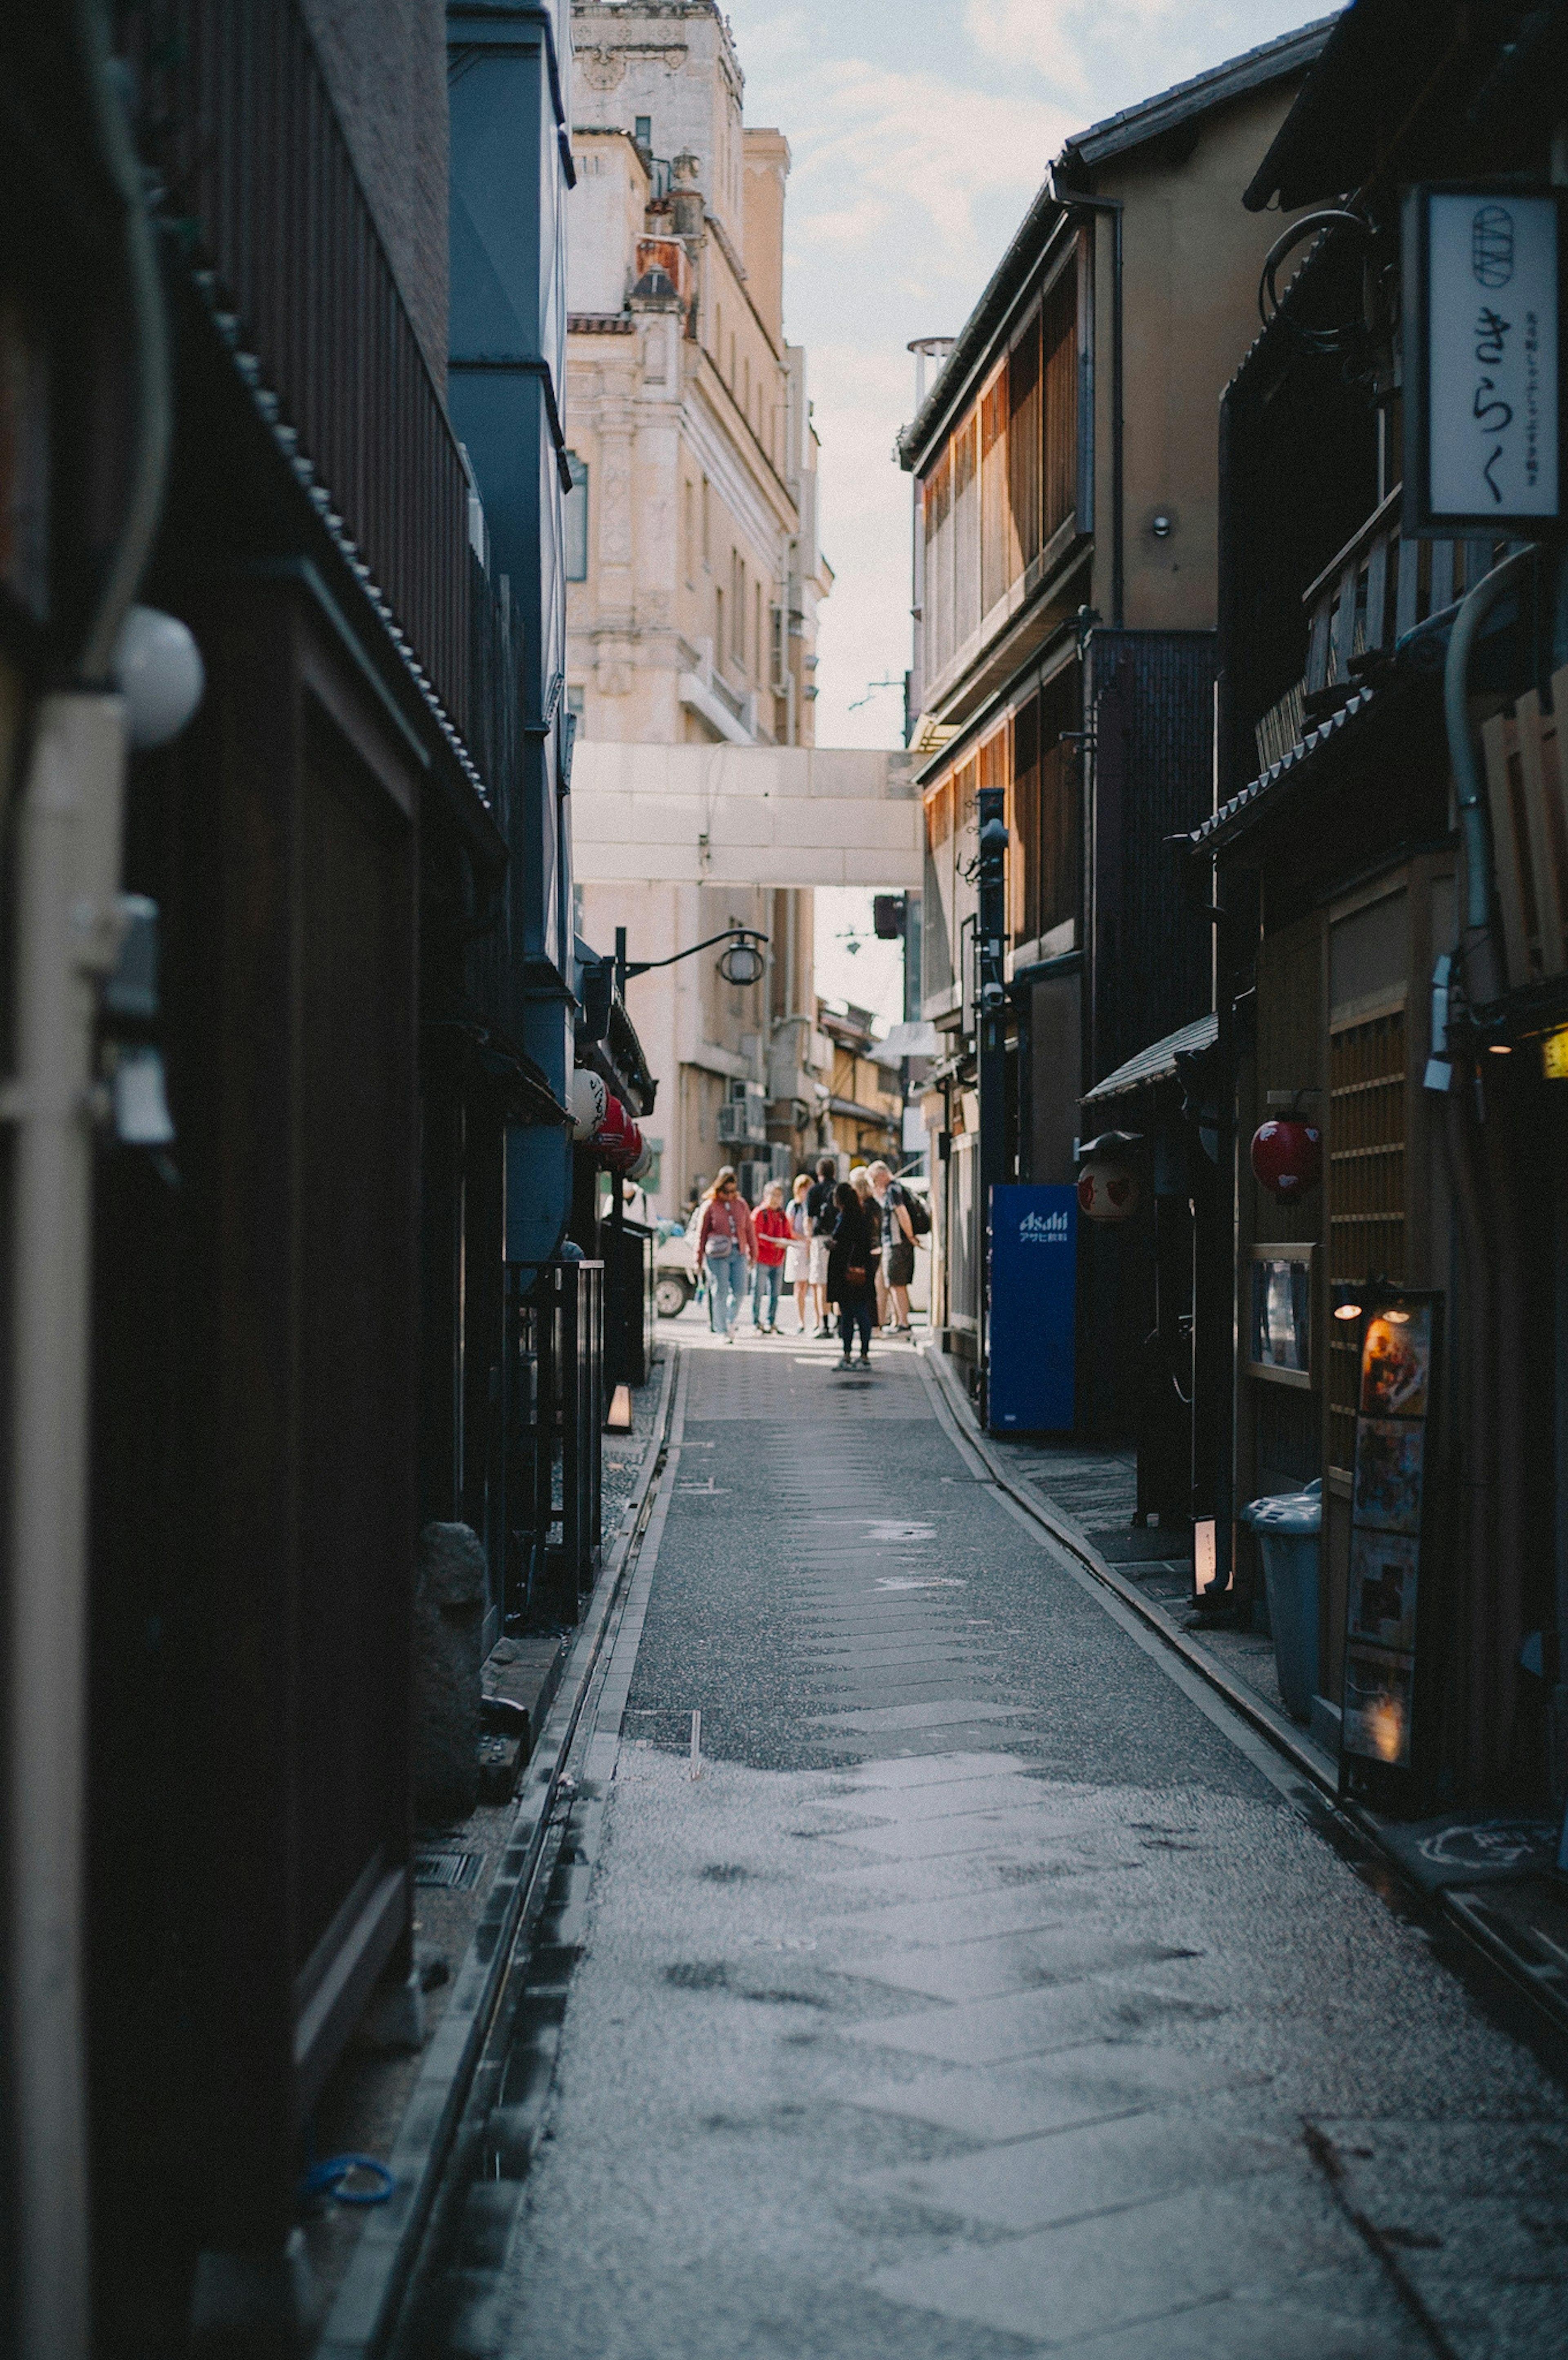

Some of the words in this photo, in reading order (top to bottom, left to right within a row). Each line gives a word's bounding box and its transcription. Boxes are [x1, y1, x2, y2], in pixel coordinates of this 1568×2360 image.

[1473, 306, 1513, 504] きらく
[1020, 1211, 1068, 1231] Asahi
